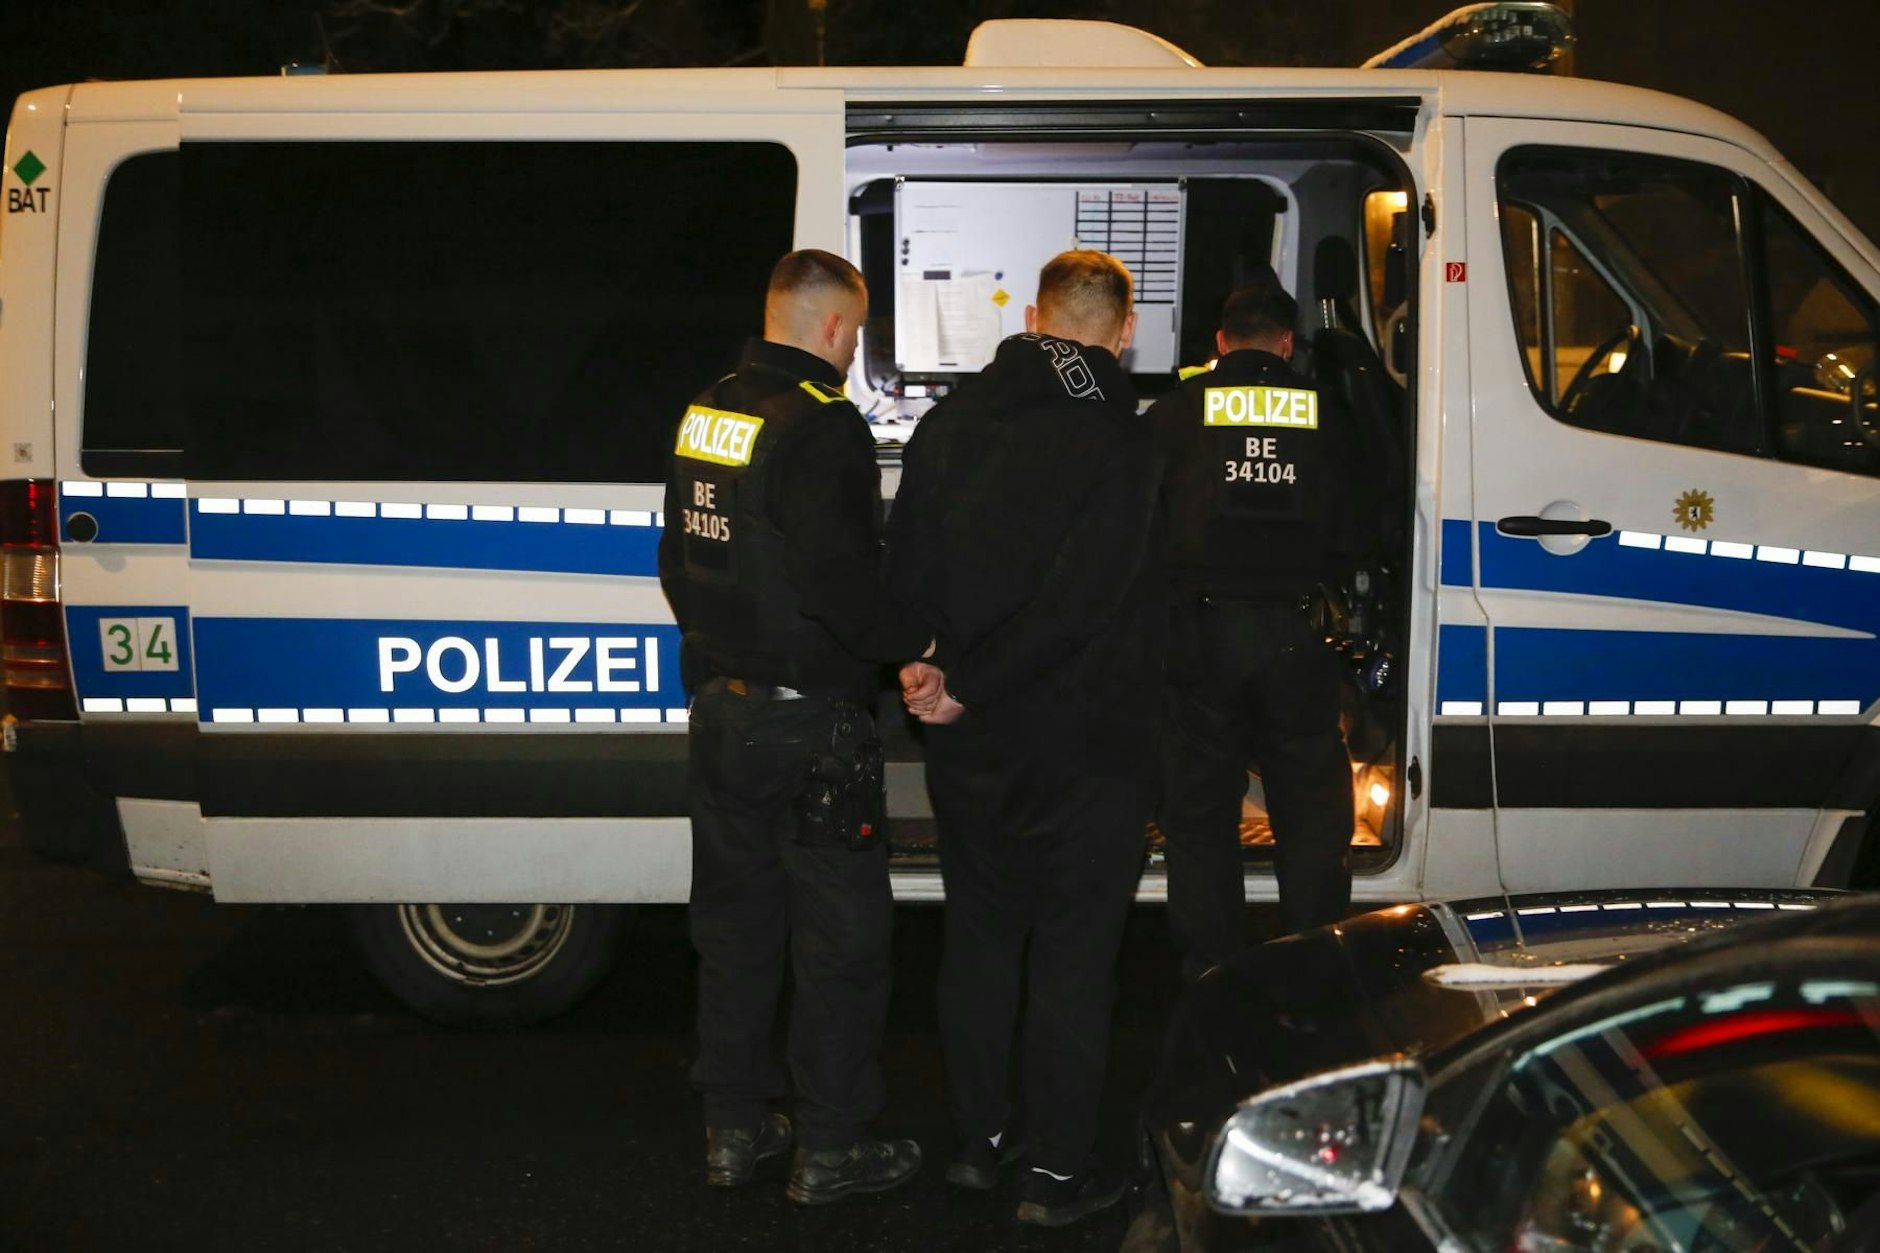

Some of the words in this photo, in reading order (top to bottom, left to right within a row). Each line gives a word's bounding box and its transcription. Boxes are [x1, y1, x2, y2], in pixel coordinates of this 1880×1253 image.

[8, 187, 51, 213] BAT
[1206, 389, 1315, 426] POLIZEI
[679, 412, 757, 462] POLIZEI
[1245, 437, 1277, 459] BE
[1225, 460, 1296, 485] 34104
[693, 480, 716, 510] BE
[682, 508, 731, 542] 34105
[107, 624, 173, 666] 34
[378, 636, 660, 693] POLIZEI
